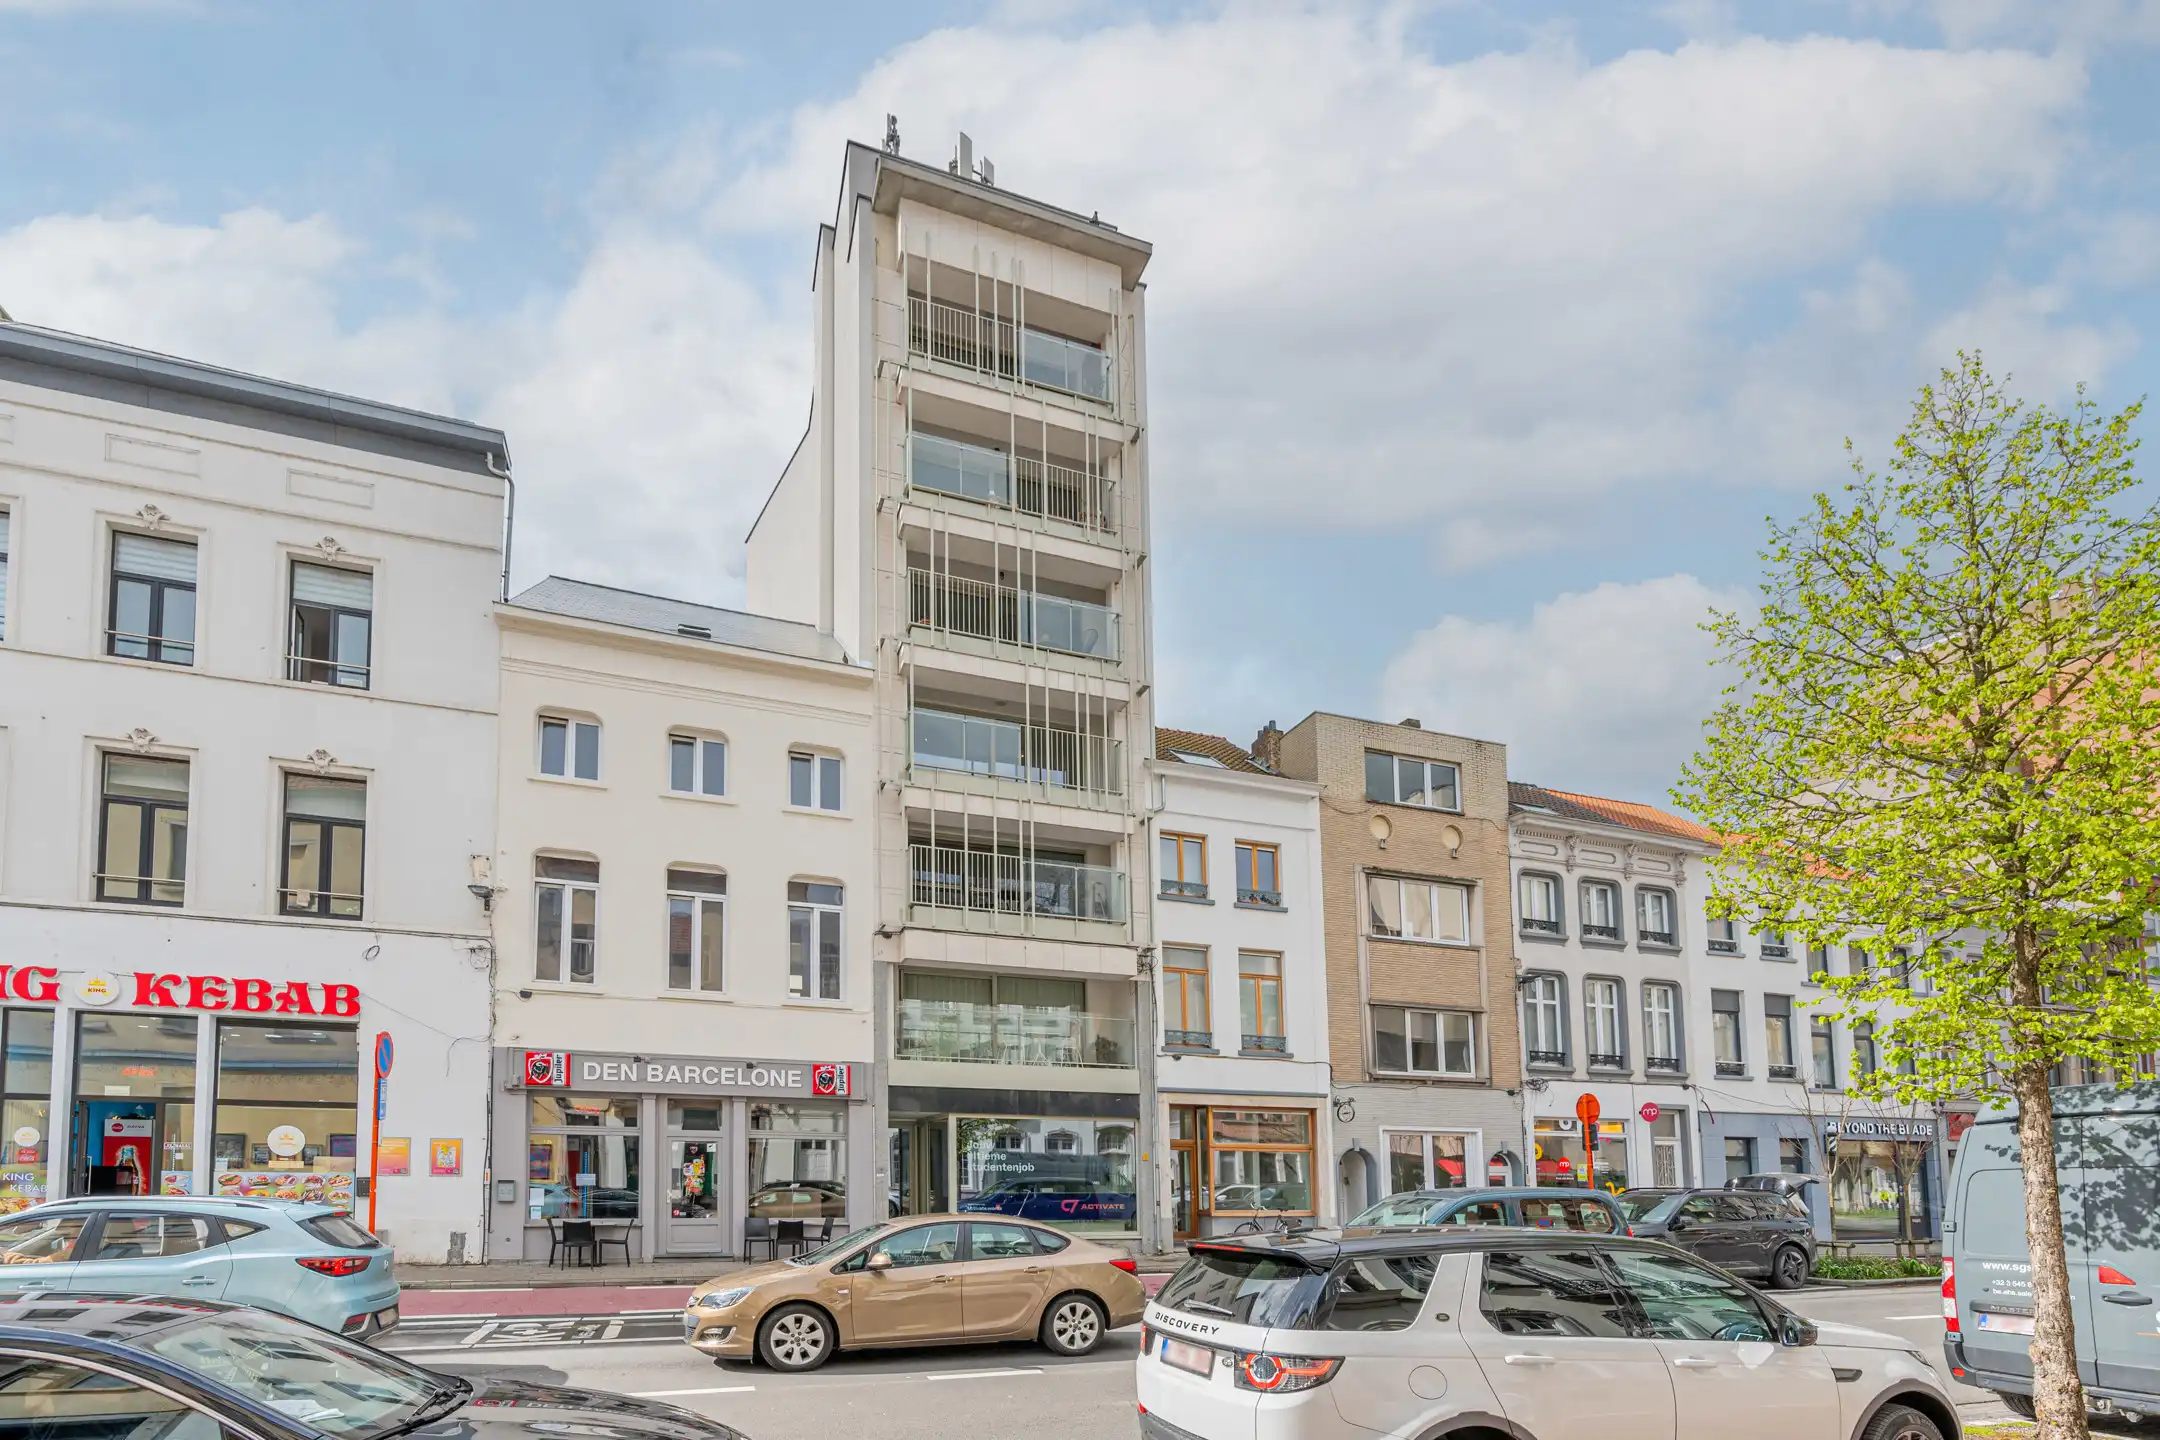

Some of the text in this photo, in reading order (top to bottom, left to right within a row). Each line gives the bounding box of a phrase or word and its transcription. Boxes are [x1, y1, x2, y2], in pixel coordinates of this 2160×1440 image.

[132, 972, 361, 1018] KEBAB
[554, 1054, 564, 1084] Jupiler
[583, 1061, 803, 1088] DEN BARCELONE
[837, 1065, 846, 1093] Jupiler
[1876, 1123, 1897, 1135] THE
[2, 1172, 35, 1181] KING
[10, 1184, 48, 1193] KEBAB
[1982, 1262, 2032, 1273] www.sgs
[1155, 1311, 1220, 1335] DISCOVERY
